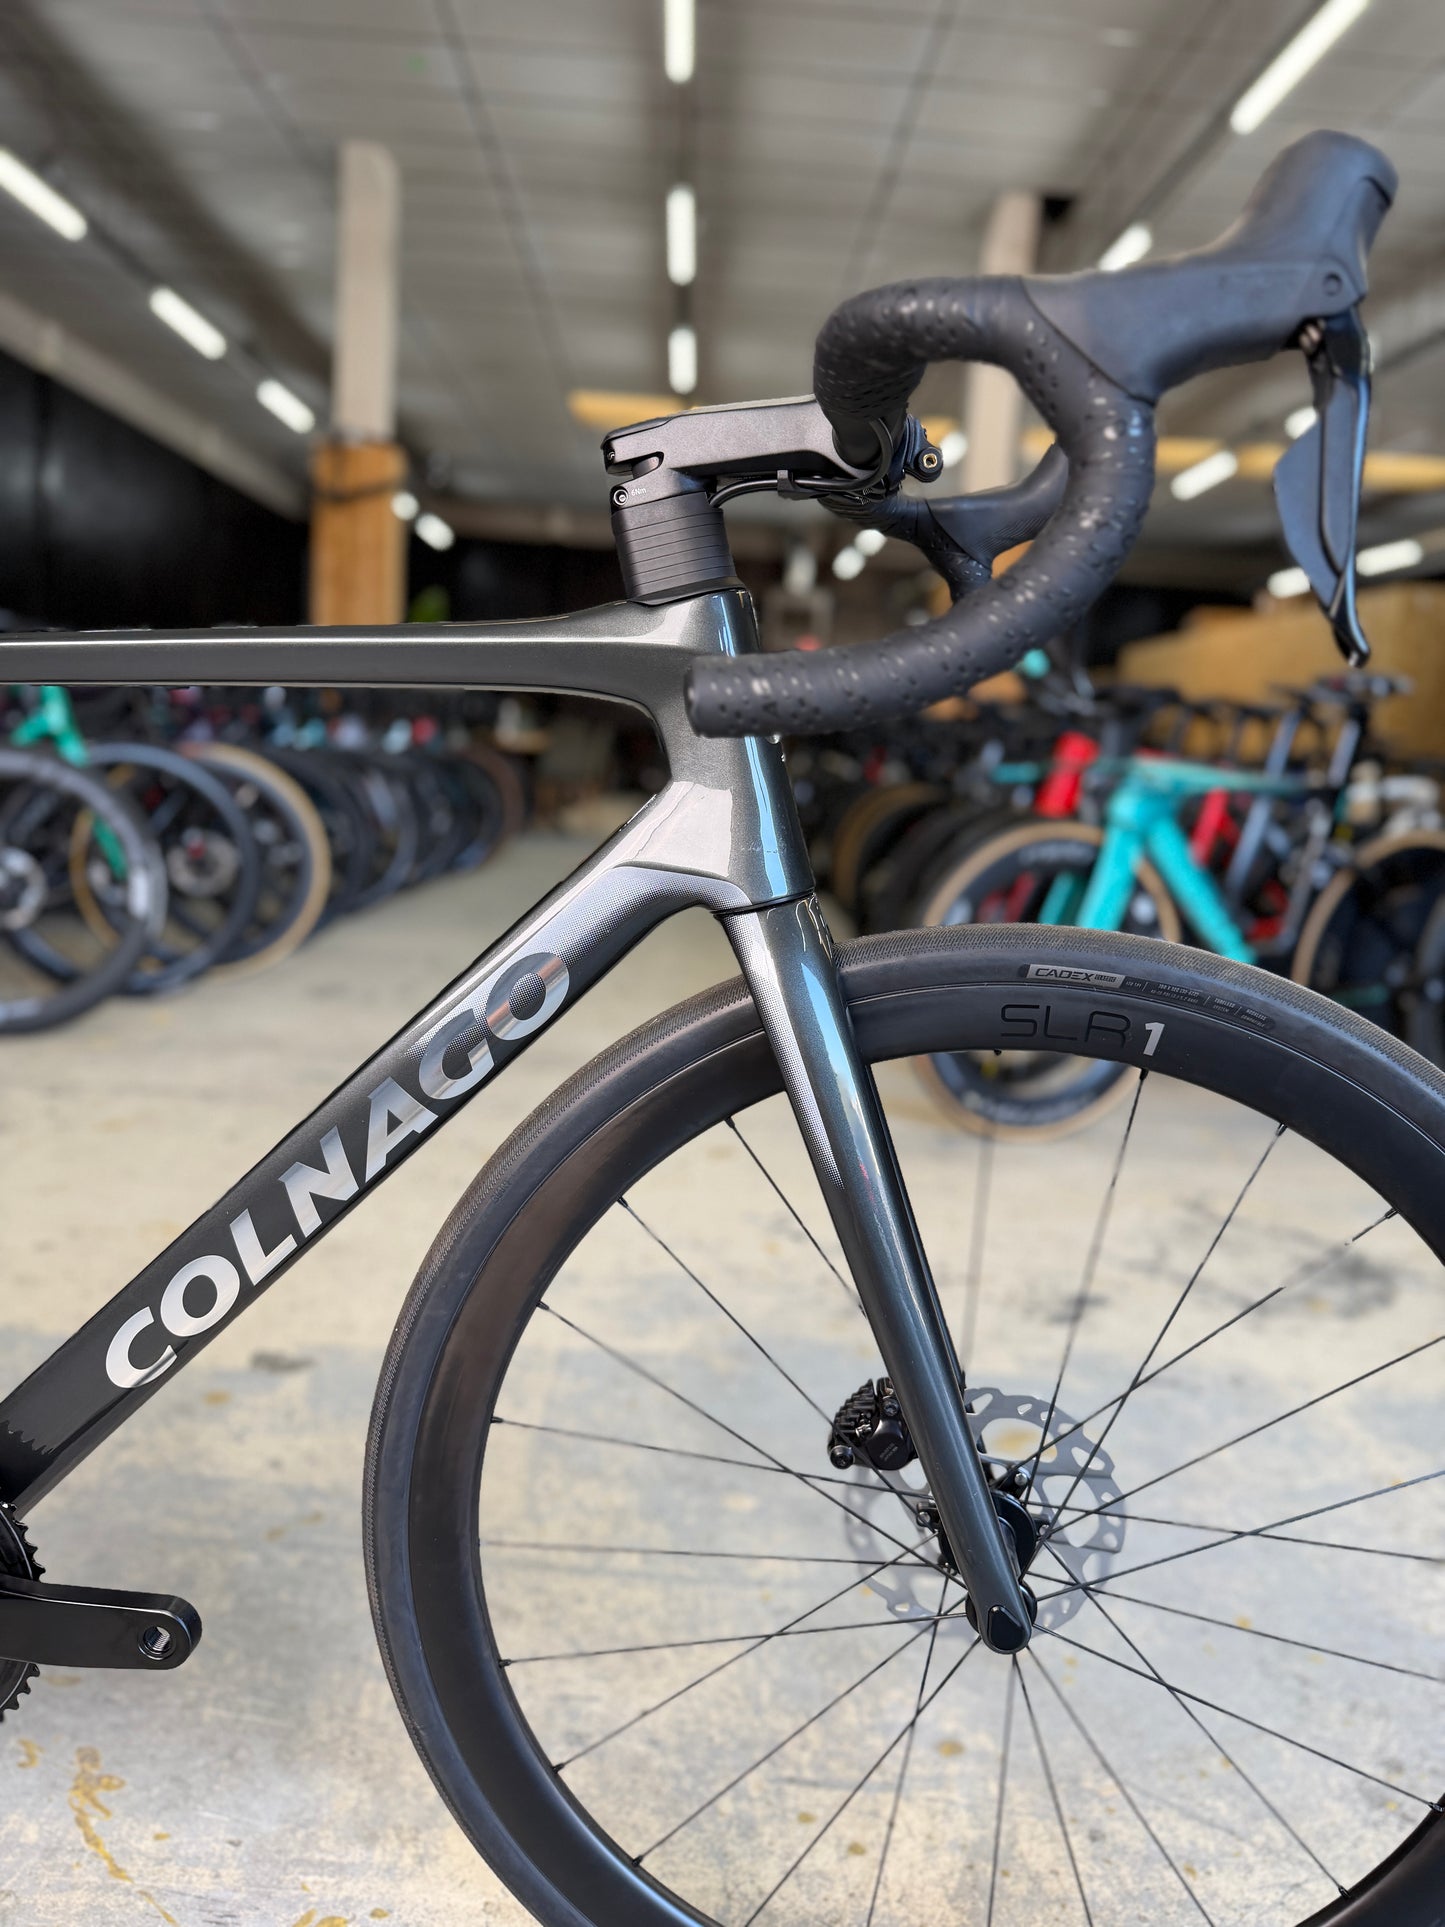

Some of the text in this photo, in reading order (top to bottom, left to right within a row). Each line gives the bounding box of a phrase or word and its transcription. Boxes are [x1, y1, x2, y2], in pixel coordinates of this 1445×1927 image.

[630, 488, 647, 497] 6Nm
[1034, 968, 1094, 982] CADEX
[1001, 1004, 1165, 1056] SLR 1
[105, 952, 570, 1389] COLNAGO
